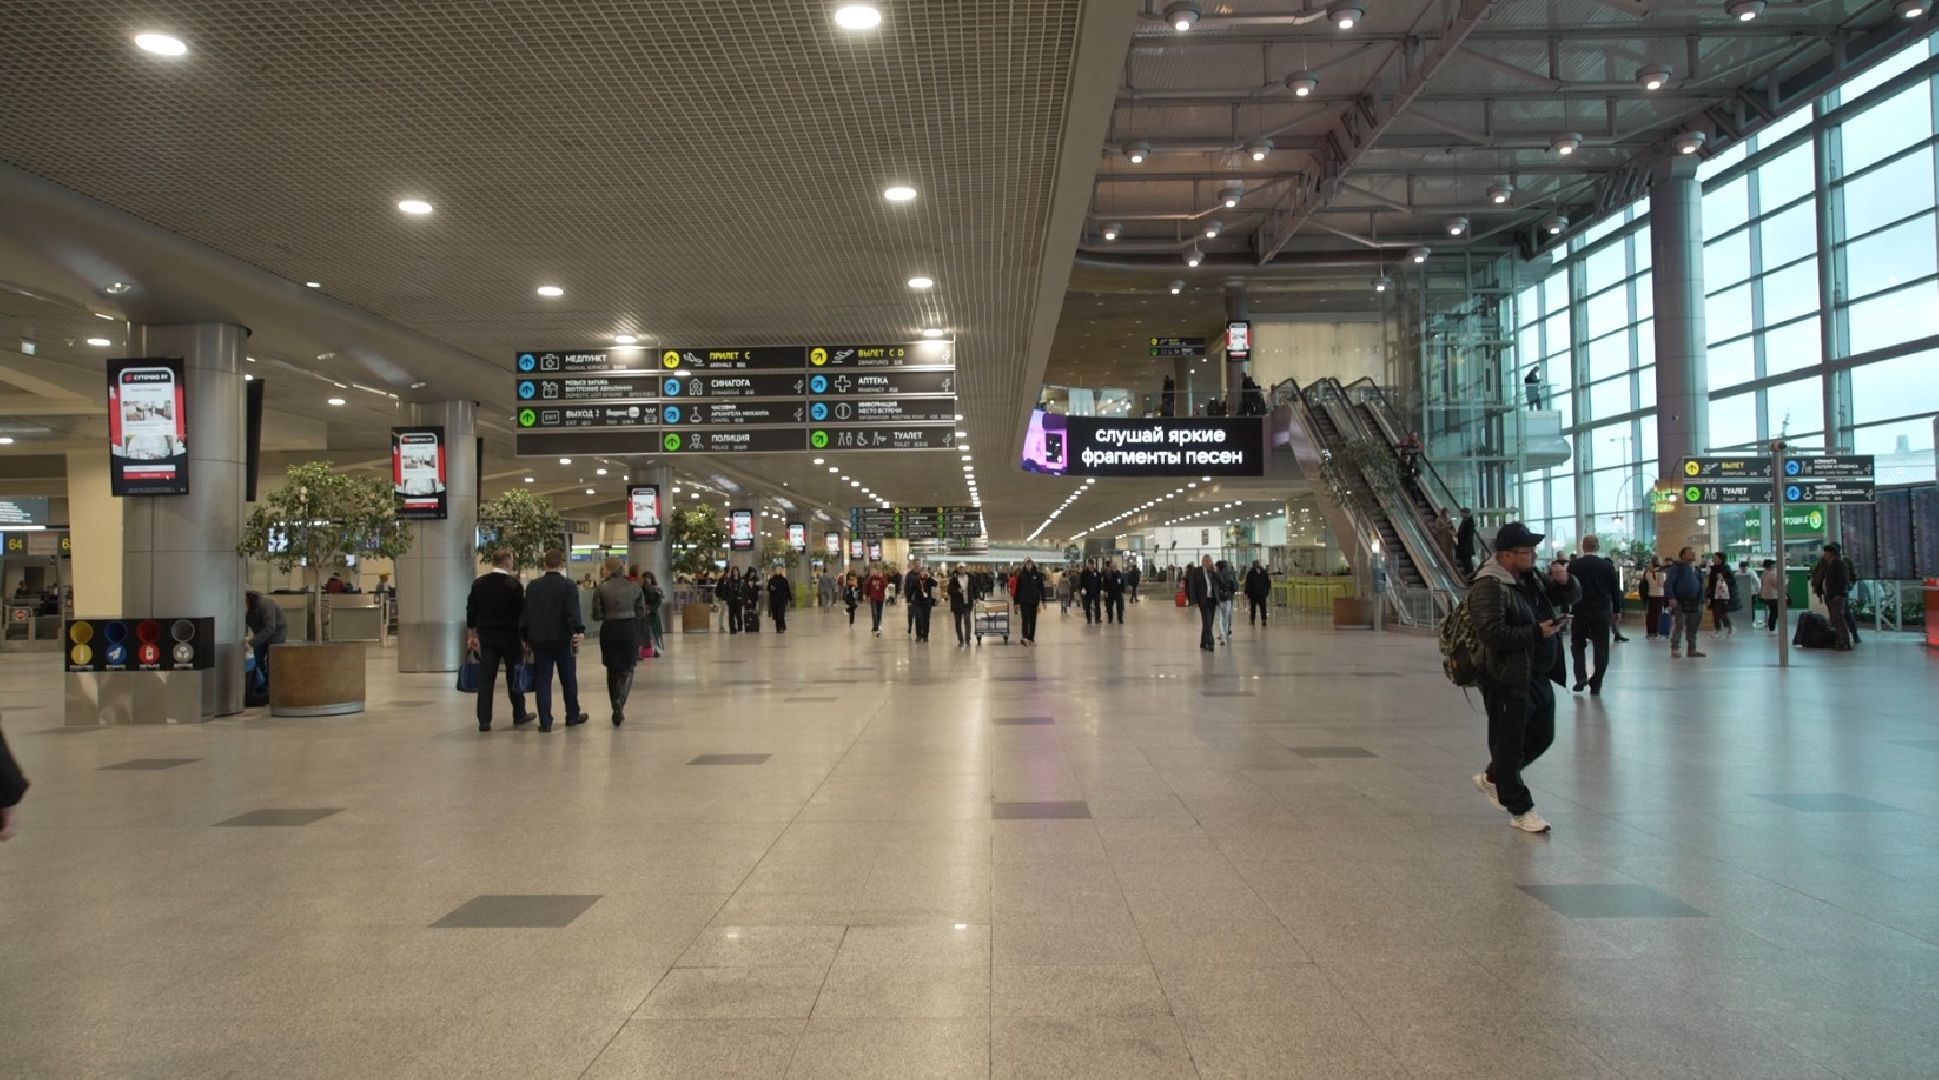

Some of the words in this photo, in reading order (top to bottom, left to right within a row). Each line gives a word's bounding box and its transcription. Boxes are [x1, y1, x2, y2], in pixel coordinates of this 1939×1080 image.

[565, 354, 607, 362] МЕДПУНКТ
[710, 352, 739, 360] ПРИЛЕТ
[711, 380, 750, 388] СИНАГОГА
[712, 434, 750, 442] ПОЛИЦИЯ
[1095, 426, 1164, 446] слушай
[1168, 429, 1226, 446] яркие
[1082, 447, 1181, 467] фрагменты
[1186, 451, 1242, 464] песен
[9, 538, 22, 550] 64
[62, 538, 70, 550] 6
